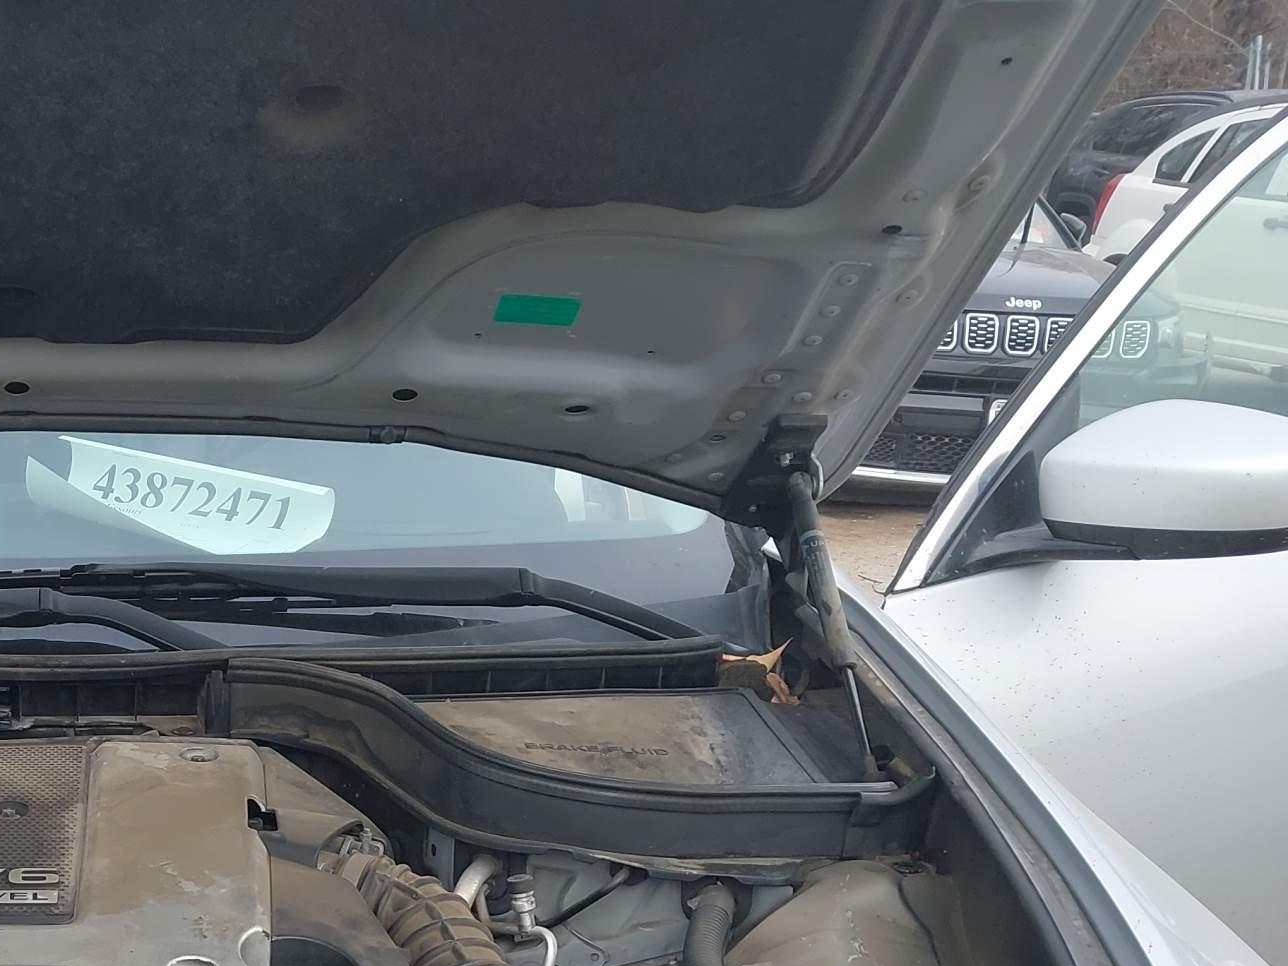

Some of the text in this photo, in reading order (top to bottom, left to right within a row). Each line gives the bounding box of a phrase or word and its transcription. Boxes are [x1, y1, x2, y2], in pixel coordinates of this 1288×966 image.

[1005, 297, 1042, 310] Jeep
[92, 463, 292, 530] 43872471
[524, 742, 669, 756] BRAKE FLUID
